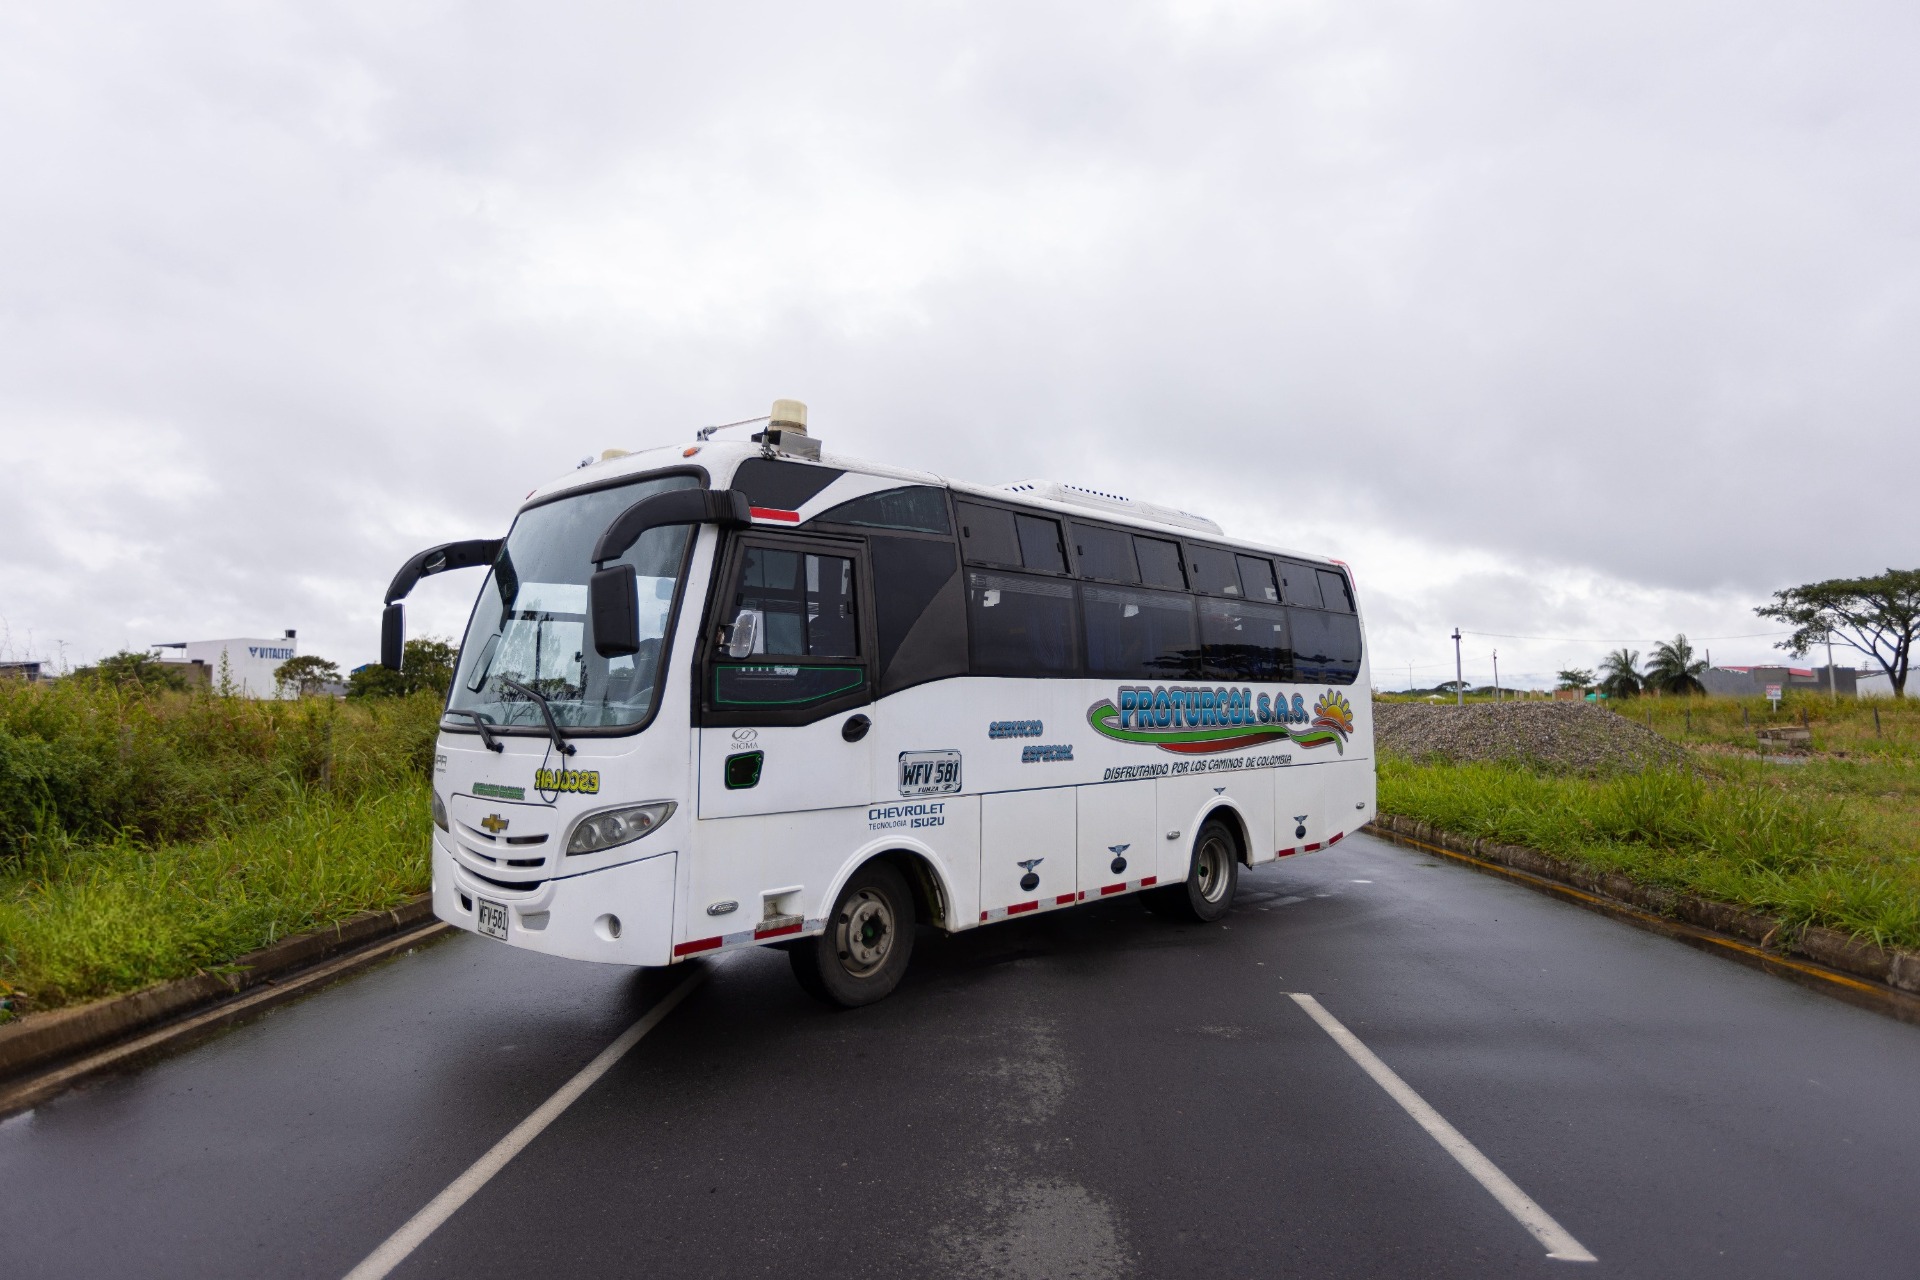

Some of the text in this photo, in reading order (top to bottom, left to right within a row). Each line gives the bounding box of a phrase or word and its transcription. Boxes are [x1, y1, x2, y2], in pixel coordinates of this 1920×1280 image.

[260, 647, 294, 660] VITALTEC
[1119, 687, 1310, 729] PROTURCOL S.A.S.
[989, 720, 1043, 739] SERVICIO
[731, 742, 758, 750] SIGMA
[1022, 745, 1073, 763] ESPECIAL
[902, 760, 959, 786] WFV 581
[1103, 754, 1292, 780] DISFRUTANDO POR LOS CAMINOS DE COLOMBIA
[868, 803, 946, 821] CHEVROLET
[868, 816, 945, 831] TECNOLOGIA ISUZU
